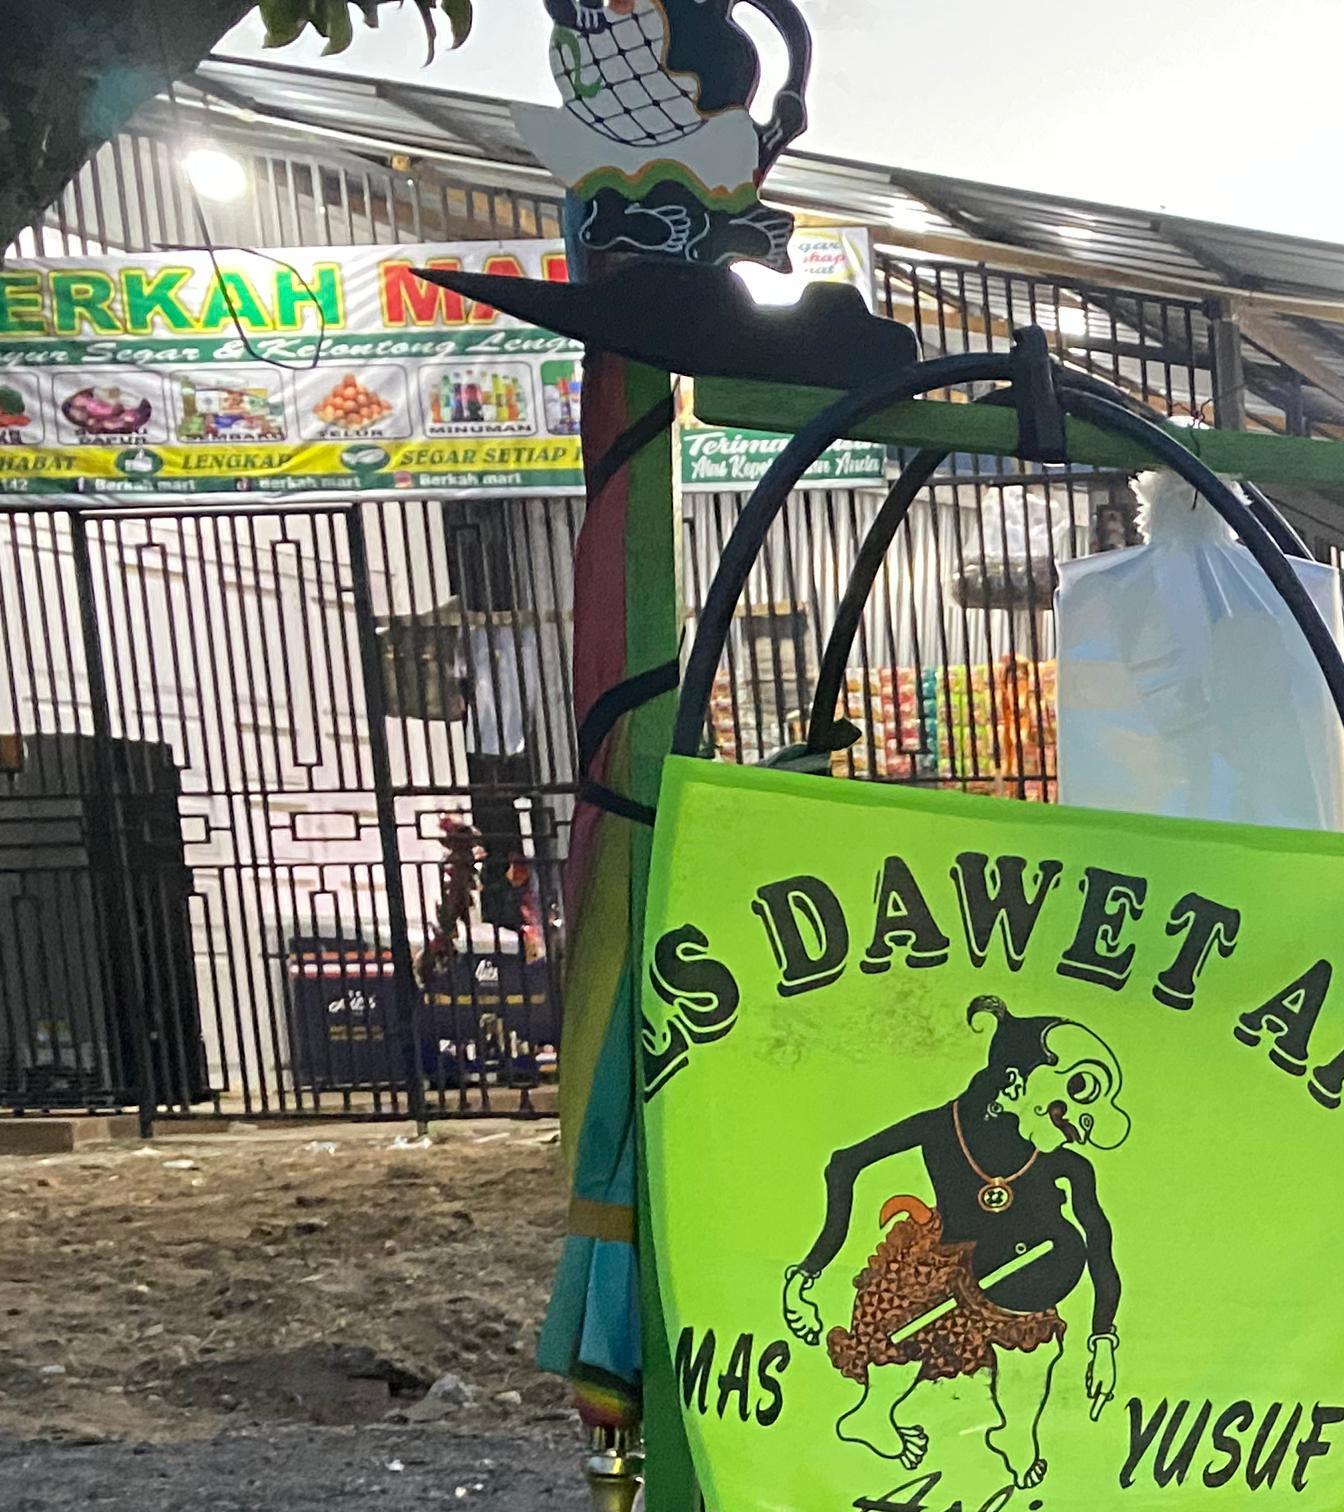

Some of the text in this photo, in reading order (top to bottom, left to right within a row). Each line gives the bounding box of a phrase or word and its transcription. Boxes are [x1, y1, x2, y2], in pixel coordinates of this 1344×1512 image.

[0, 261, 346, 336] ERKAH
[1, 331, 585, 368] yur Segar & Kelontong Leng
[428, 424, 533, 434] MINUMAN
[399, 447, 478, 466] SEGAR
[482, 445, 567, 465] SETIAP
[683, 430, 788, 456] Terima
[0, 453, 292, 471] HABAT LENGKAP
[419, 472, 522, 486] Berkah mart
[751, 850, 1241, 1011] DAWET
[673, 1326, 791, 1427] MAS
